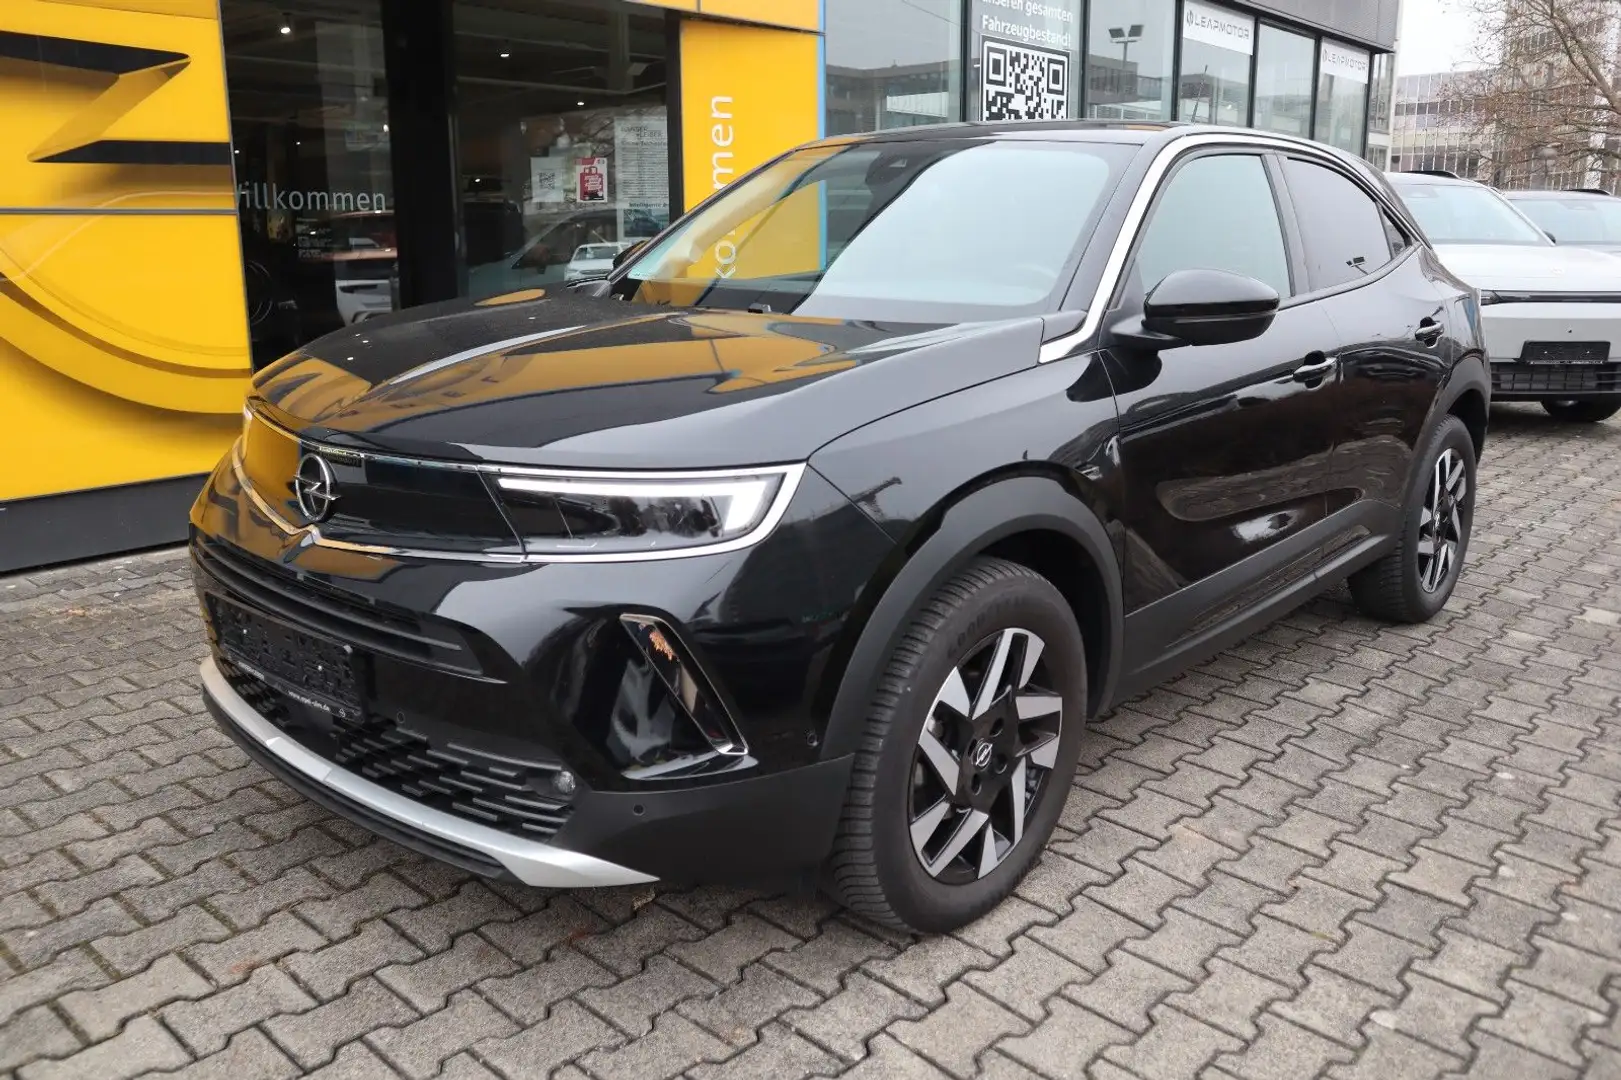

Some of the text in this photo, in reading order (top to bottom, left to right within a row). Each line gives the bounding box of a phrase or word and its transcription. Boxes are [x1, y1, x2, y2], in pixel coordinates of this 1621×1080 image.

[1025, 1, 1073, 23] gesamten
[982, 14, 1071, 46] Fahrzeugbestand!
[1194, 15, 1250, 40] LEAPMOTOR
[239, 181, 386, 211] illkommen
